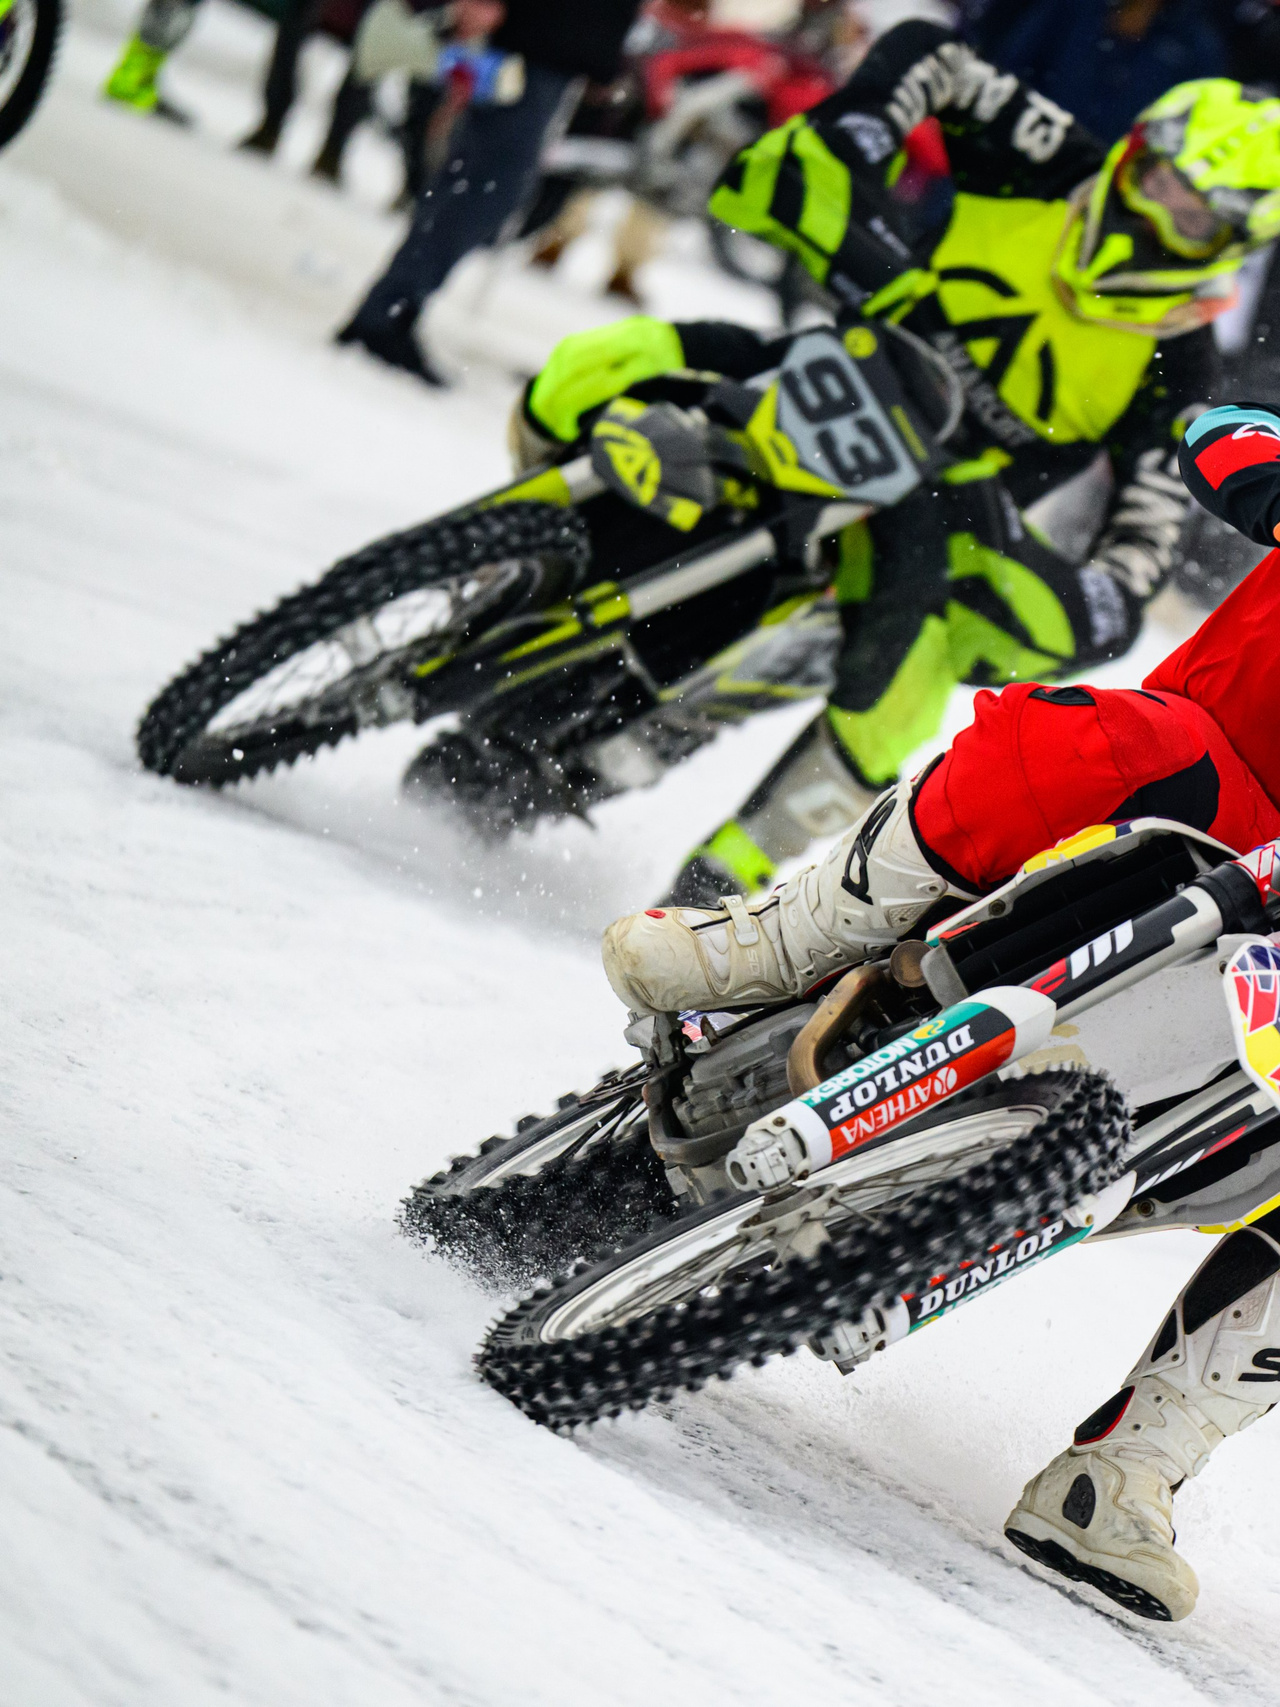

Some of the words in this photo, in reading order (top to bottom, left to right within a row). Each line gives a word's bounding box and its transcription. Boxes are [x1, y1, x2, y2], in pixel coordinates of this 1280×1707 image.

[780, 356, 898, 487] 93
[808, 1038, 918, 1105] MOTOREX
[829, 1024, 975, 1122] DUNLOP
[841, 1079, 932, 1144] ATHENA
[917, 1219, 1064, 1319] DUNLOP
